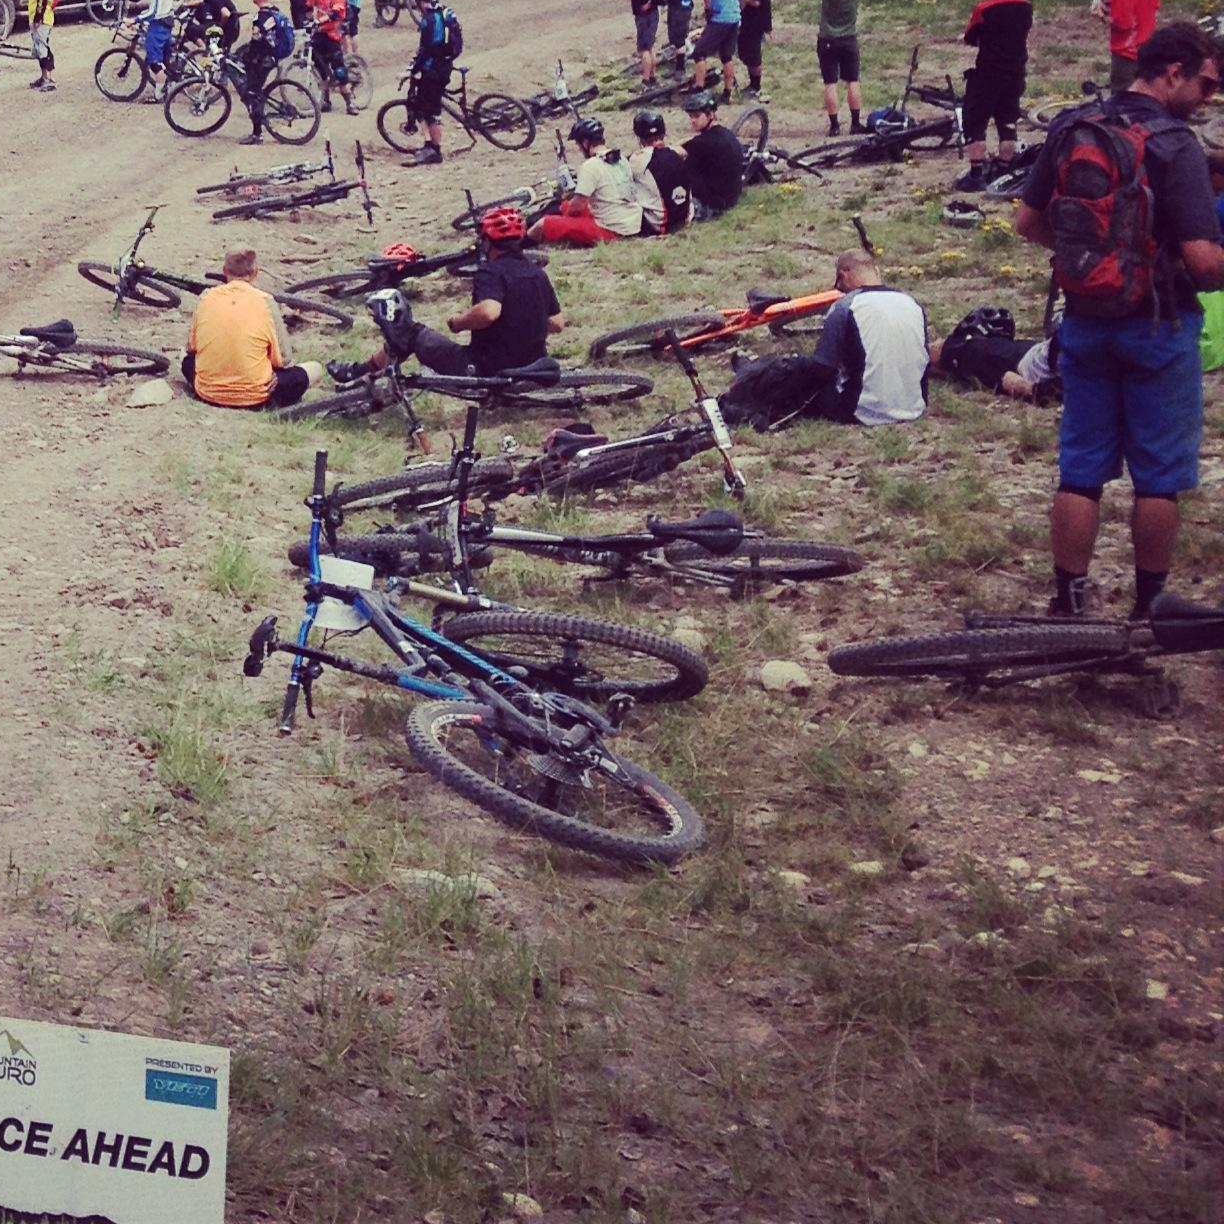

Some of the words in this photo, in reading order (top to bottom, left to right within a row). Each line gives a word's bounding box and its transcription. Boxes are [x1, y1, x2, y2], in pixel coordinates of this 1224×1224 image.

[145, 1057, 203, 1073] PRESENTED
[204, 1065, 219, 1075] BY
[60, 1128, 211, 1180] AHEAD
